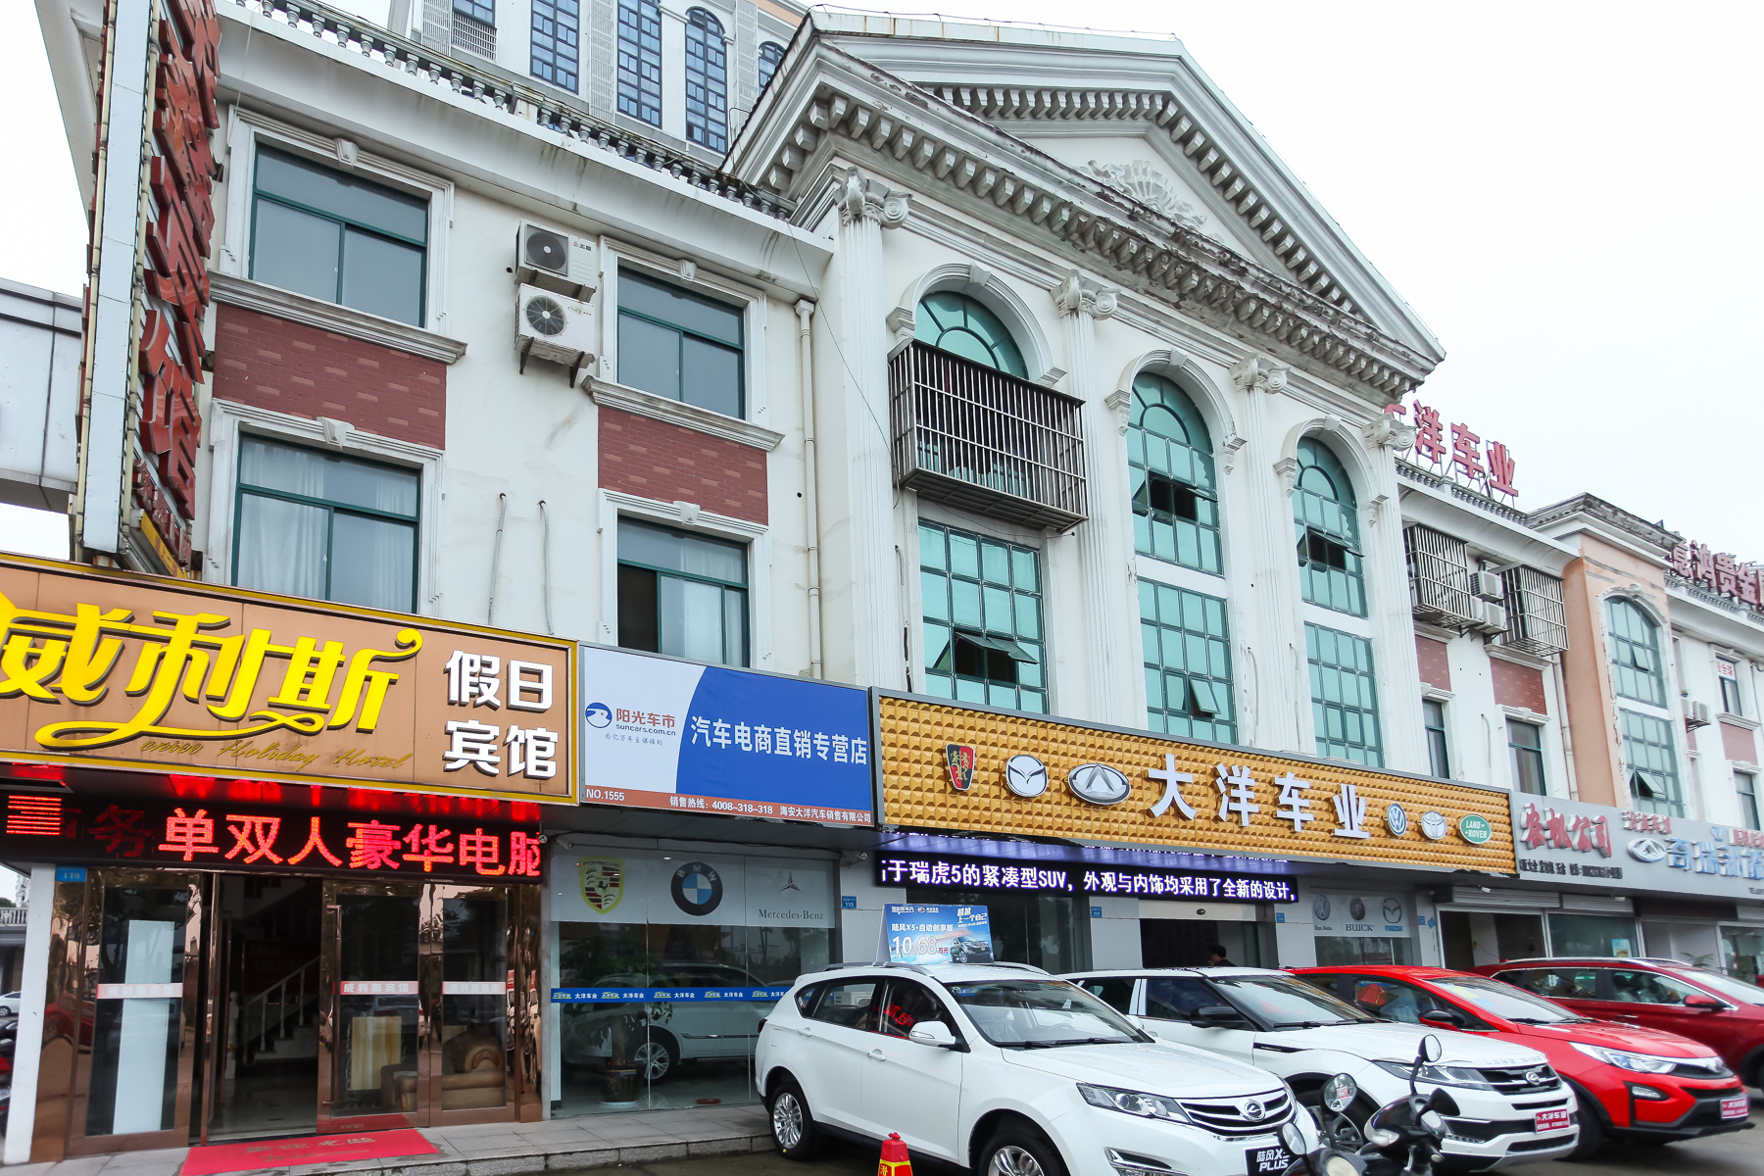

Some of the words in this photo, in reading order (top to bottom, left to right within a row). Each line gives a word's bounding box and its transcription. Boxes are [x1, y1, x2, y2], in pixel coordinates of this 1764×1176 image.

[444, 650, 555, 712] 假日
[616, 708, 676, 729] 阳光车市
[615, 723, 677, 737] suncars.com.cn
[690, 714, 868, 766] 汽车电商直销专营店
[217, 739, 321, 772] Holiday
[333, 748, 414, 769] Hotel
[443, 719, 559, 780] 宾馆
[586, 788, 626, 802] NO.1555
[1147, 753, 1371, 840] 大洋车业
[779, 805, 872, 825] 海安大洋汽车销售有限公司
[1465, 819, 1482, 830] LAND
[1468, 829, 1488, 839] ROVER
[758, 908, 824, 921] Mercedes-Benz
[1345, 923, 1374, 932] BUICK
[343, 983, 409, 994] 威利斯宾馆
[1259, 1159, 1289, 1172] PLUS
